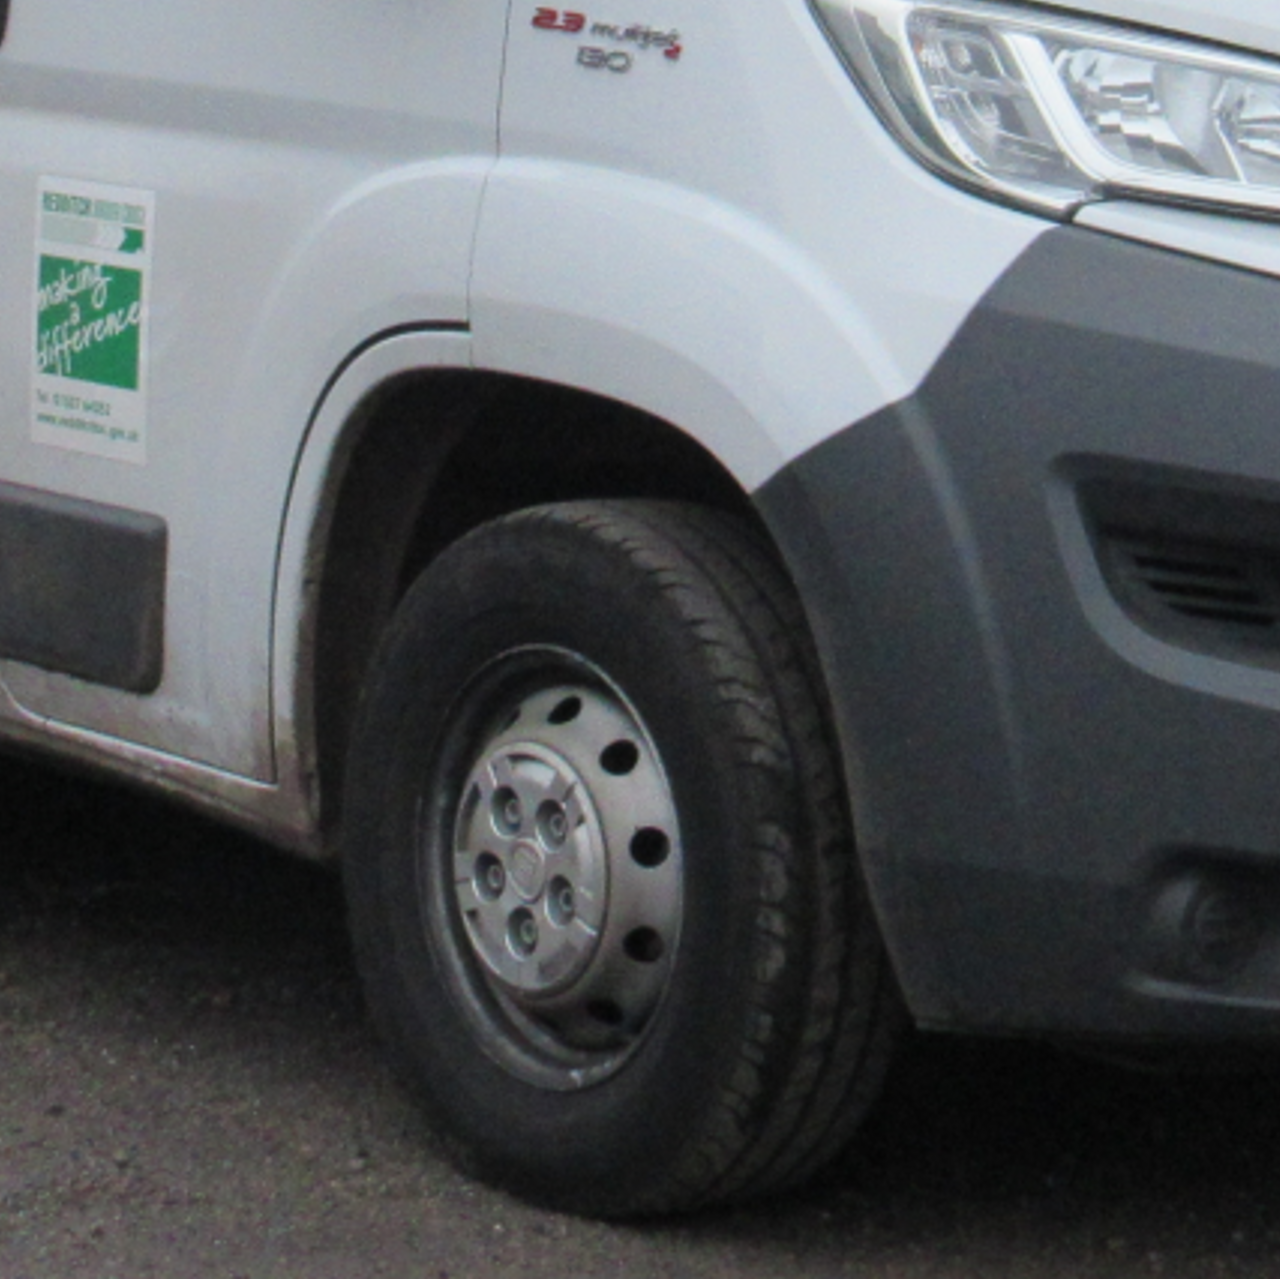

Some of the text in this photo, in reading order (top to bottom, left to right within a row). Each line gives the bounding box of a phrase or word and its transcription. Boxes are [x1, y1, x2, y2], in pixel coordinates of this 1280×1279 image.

[37, 260, 113, 310] making
[36, 301, 145, 376] difference
[69, 302, 80, 325] a
